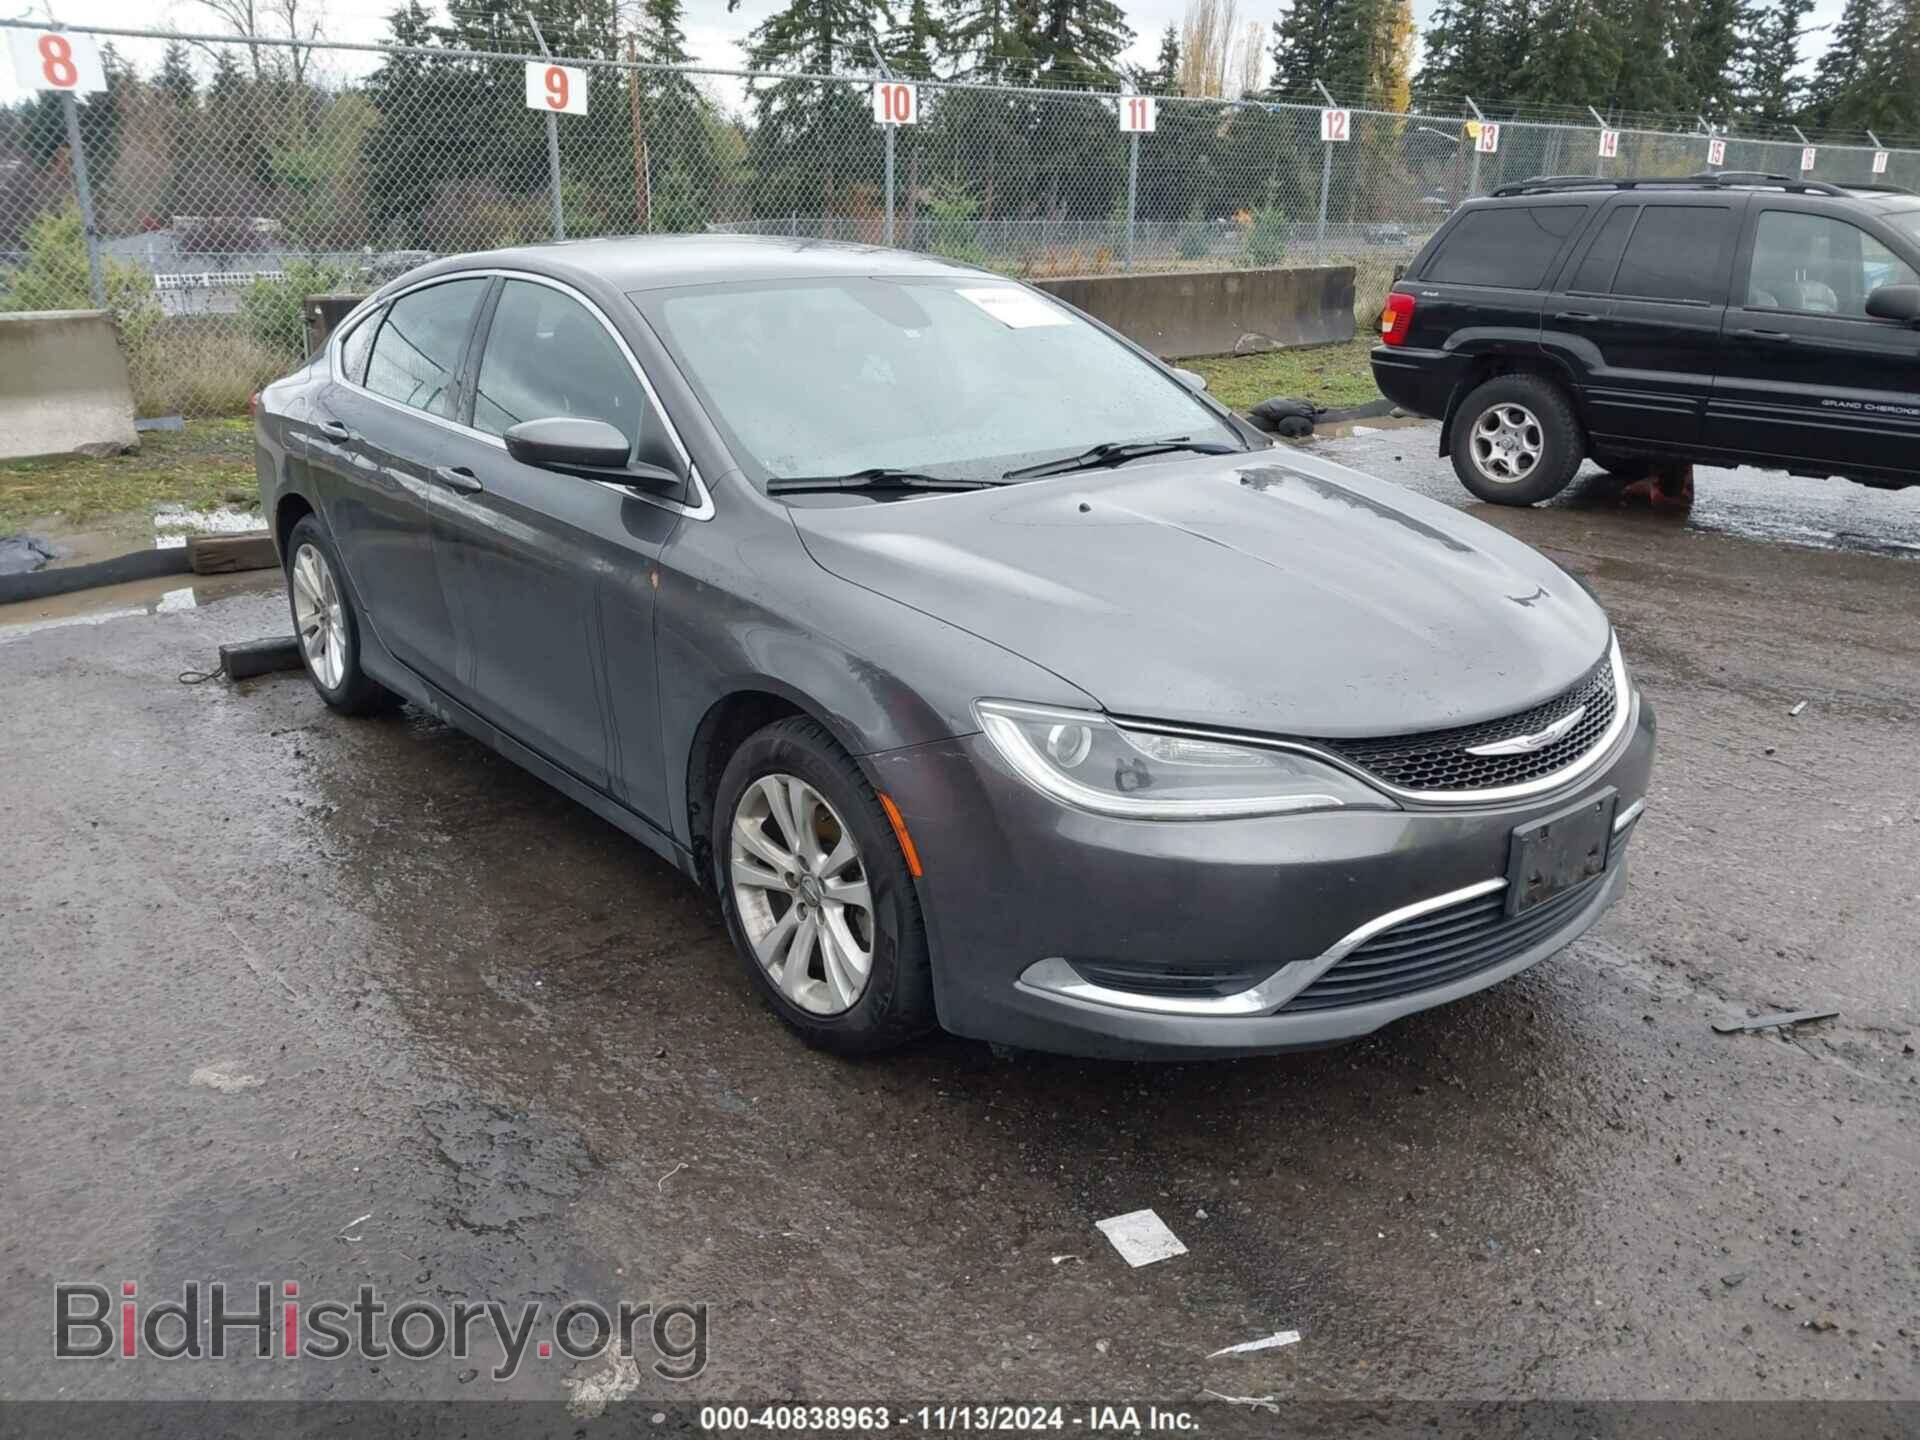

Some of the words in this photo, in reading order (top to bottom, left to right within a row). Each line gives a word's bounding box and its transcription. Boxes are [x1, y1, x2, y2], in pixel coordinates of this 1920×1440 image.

[38, 34, 78, 88] 8
[545, 65, 569, 109] 9
[881, 85, 910, 121] 10
[1129, 99, 1147, 129] 11
[1326, 111, 1346, 139] 12
[1481, 125, 1496, 150] 13
[1603, 132, 1615, 156] 14
[1712, 143, 1722, 163] 15
[1821, 399, 1862, 409] GRAND
